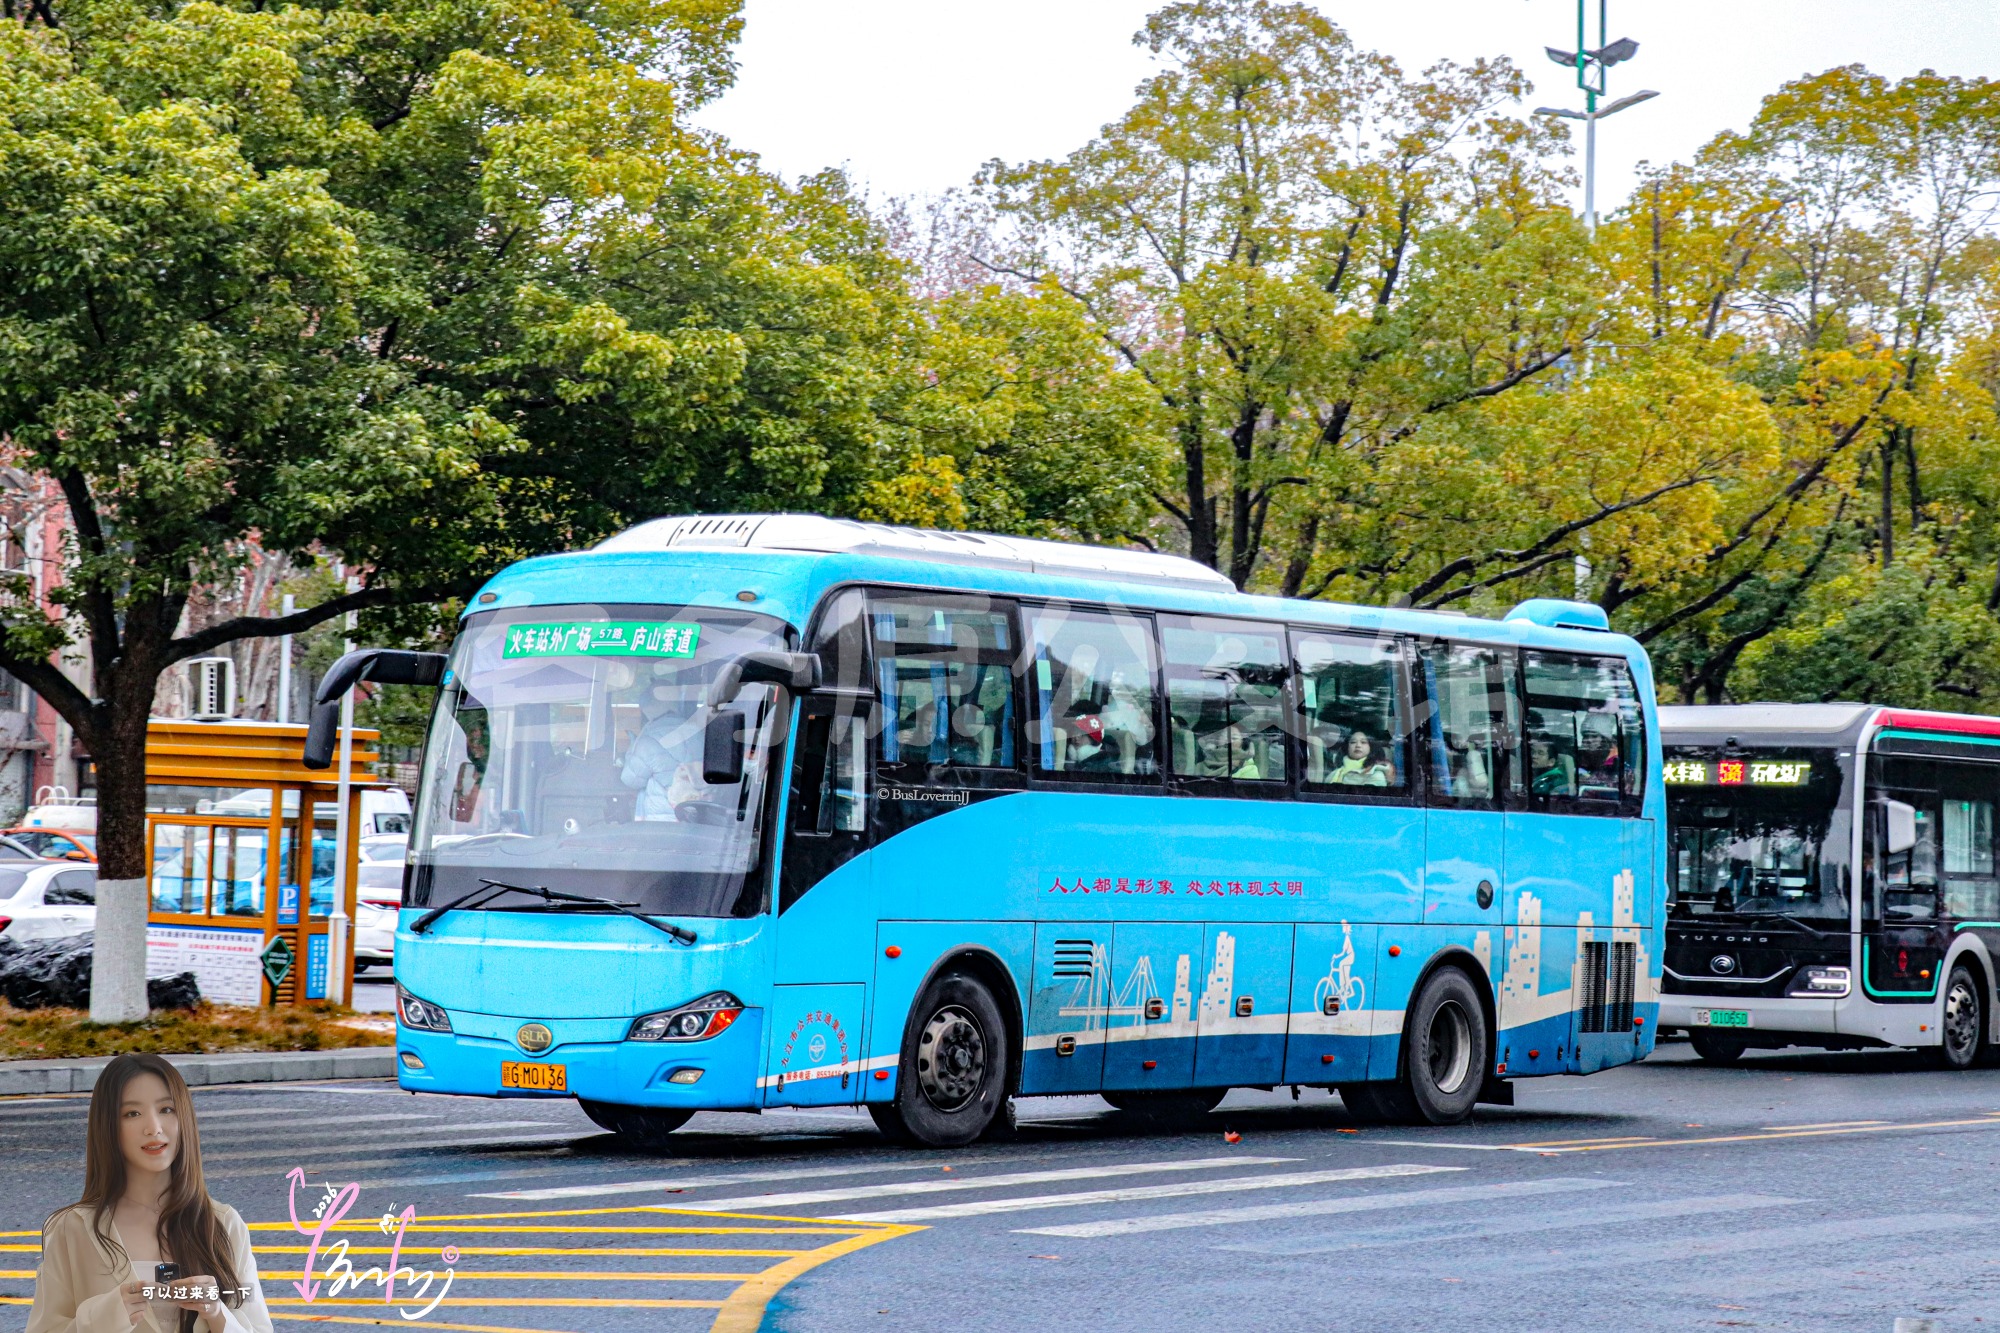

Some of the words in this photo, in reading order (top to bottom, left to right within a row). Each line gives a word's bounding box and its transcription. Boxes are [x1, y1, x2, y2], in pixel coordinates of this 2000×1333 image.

[509, 627, 592, 654] 火车站外广场
[599, 628, 624, 639] 57路
[630, 627, 694, 653] 庐山索道
[1662, 762, 1706, 783] 火车站
[1751, 763, 1811, 783] 石化总厂
[1048, 877, 1175, 895] 人人都是形象
[1186, 880, 1304, 897] 处处体现文明
[282, 888, 296, 908] P
[1680, 934, 1768, 943] YUTONG
[520, 1030, 545, 1042] BLK
